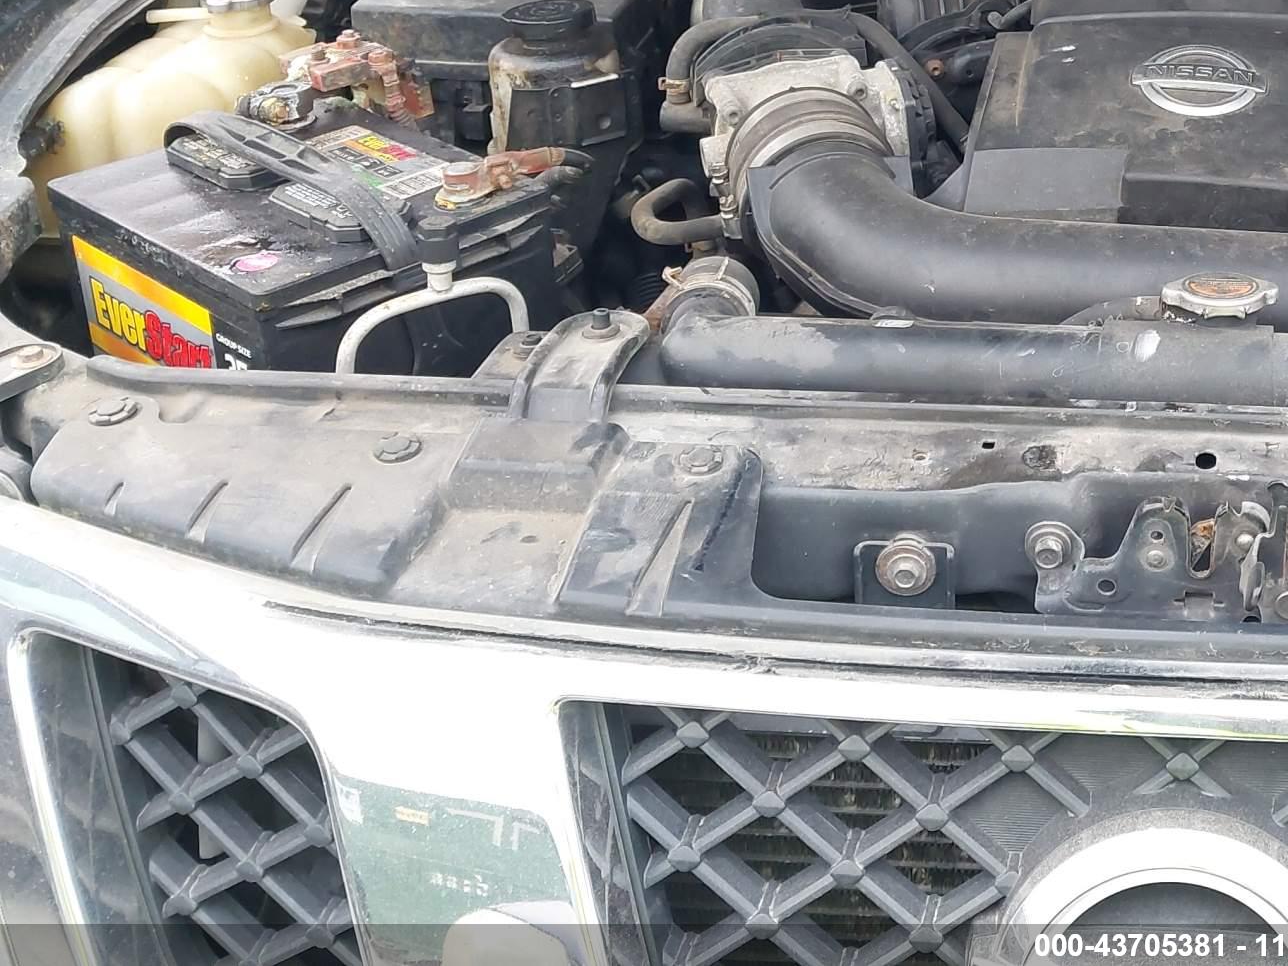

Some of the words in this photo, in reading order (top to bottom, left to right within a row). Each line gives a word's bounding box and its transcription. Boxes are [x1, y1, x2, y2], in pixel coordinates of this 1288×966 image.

[1147, 65, 1254, 83] NISSAN
[215, 333, 238, 350] GROUP
[237, 344, 253, 359] SIZE
